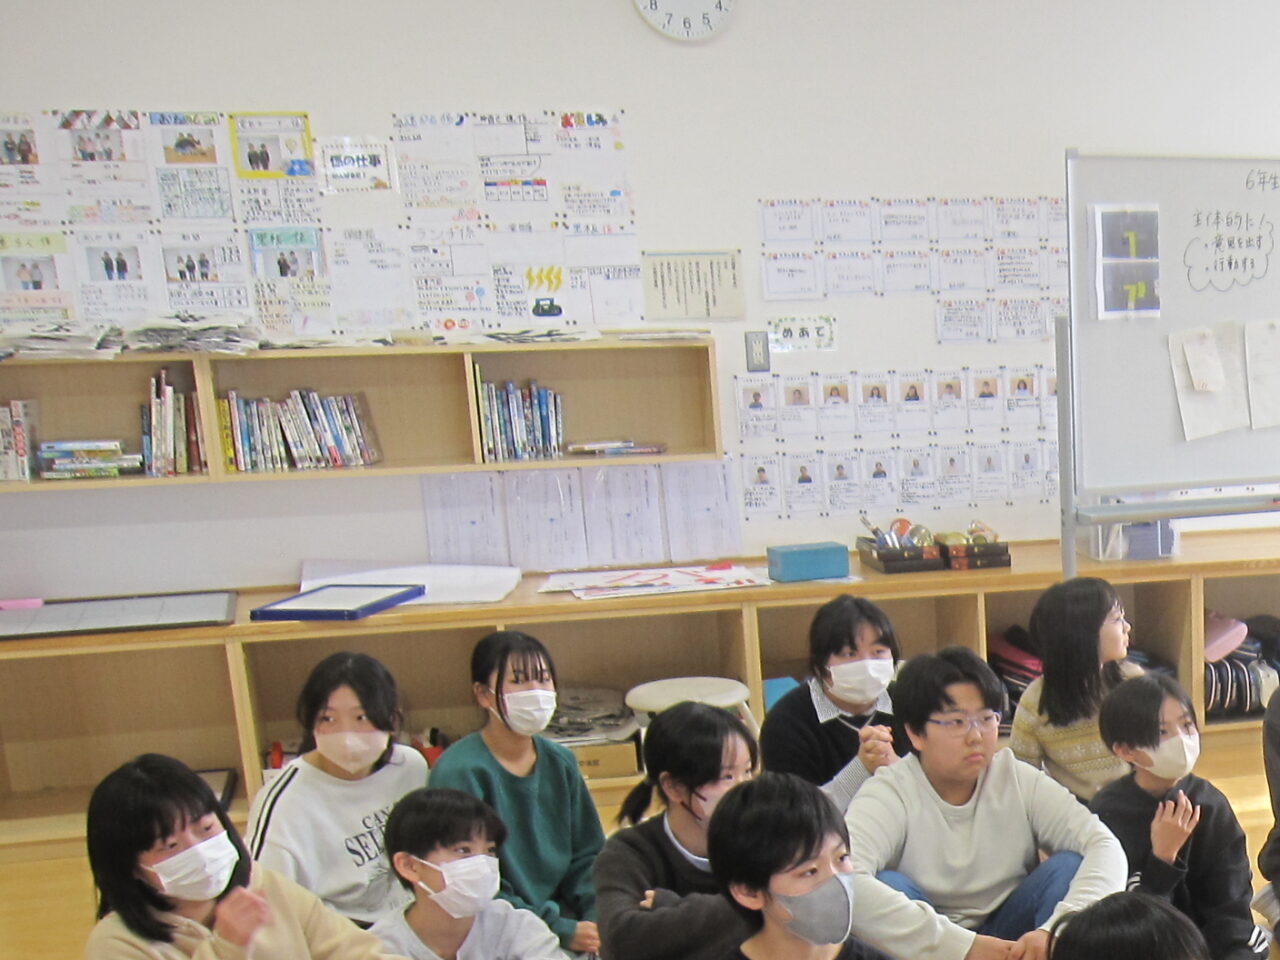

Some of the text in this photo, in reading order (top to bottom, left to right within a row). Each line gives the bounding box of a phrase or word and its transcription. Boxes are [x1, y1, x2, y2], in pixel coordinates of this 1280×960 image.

[665, 13, 673, 25] 7
[683, 17, 691, 29] 6
[702, 13, 710, 25] 5
[330, 154, 381, 168] 係の仕事
[782, 326, 825, 339] めあて
